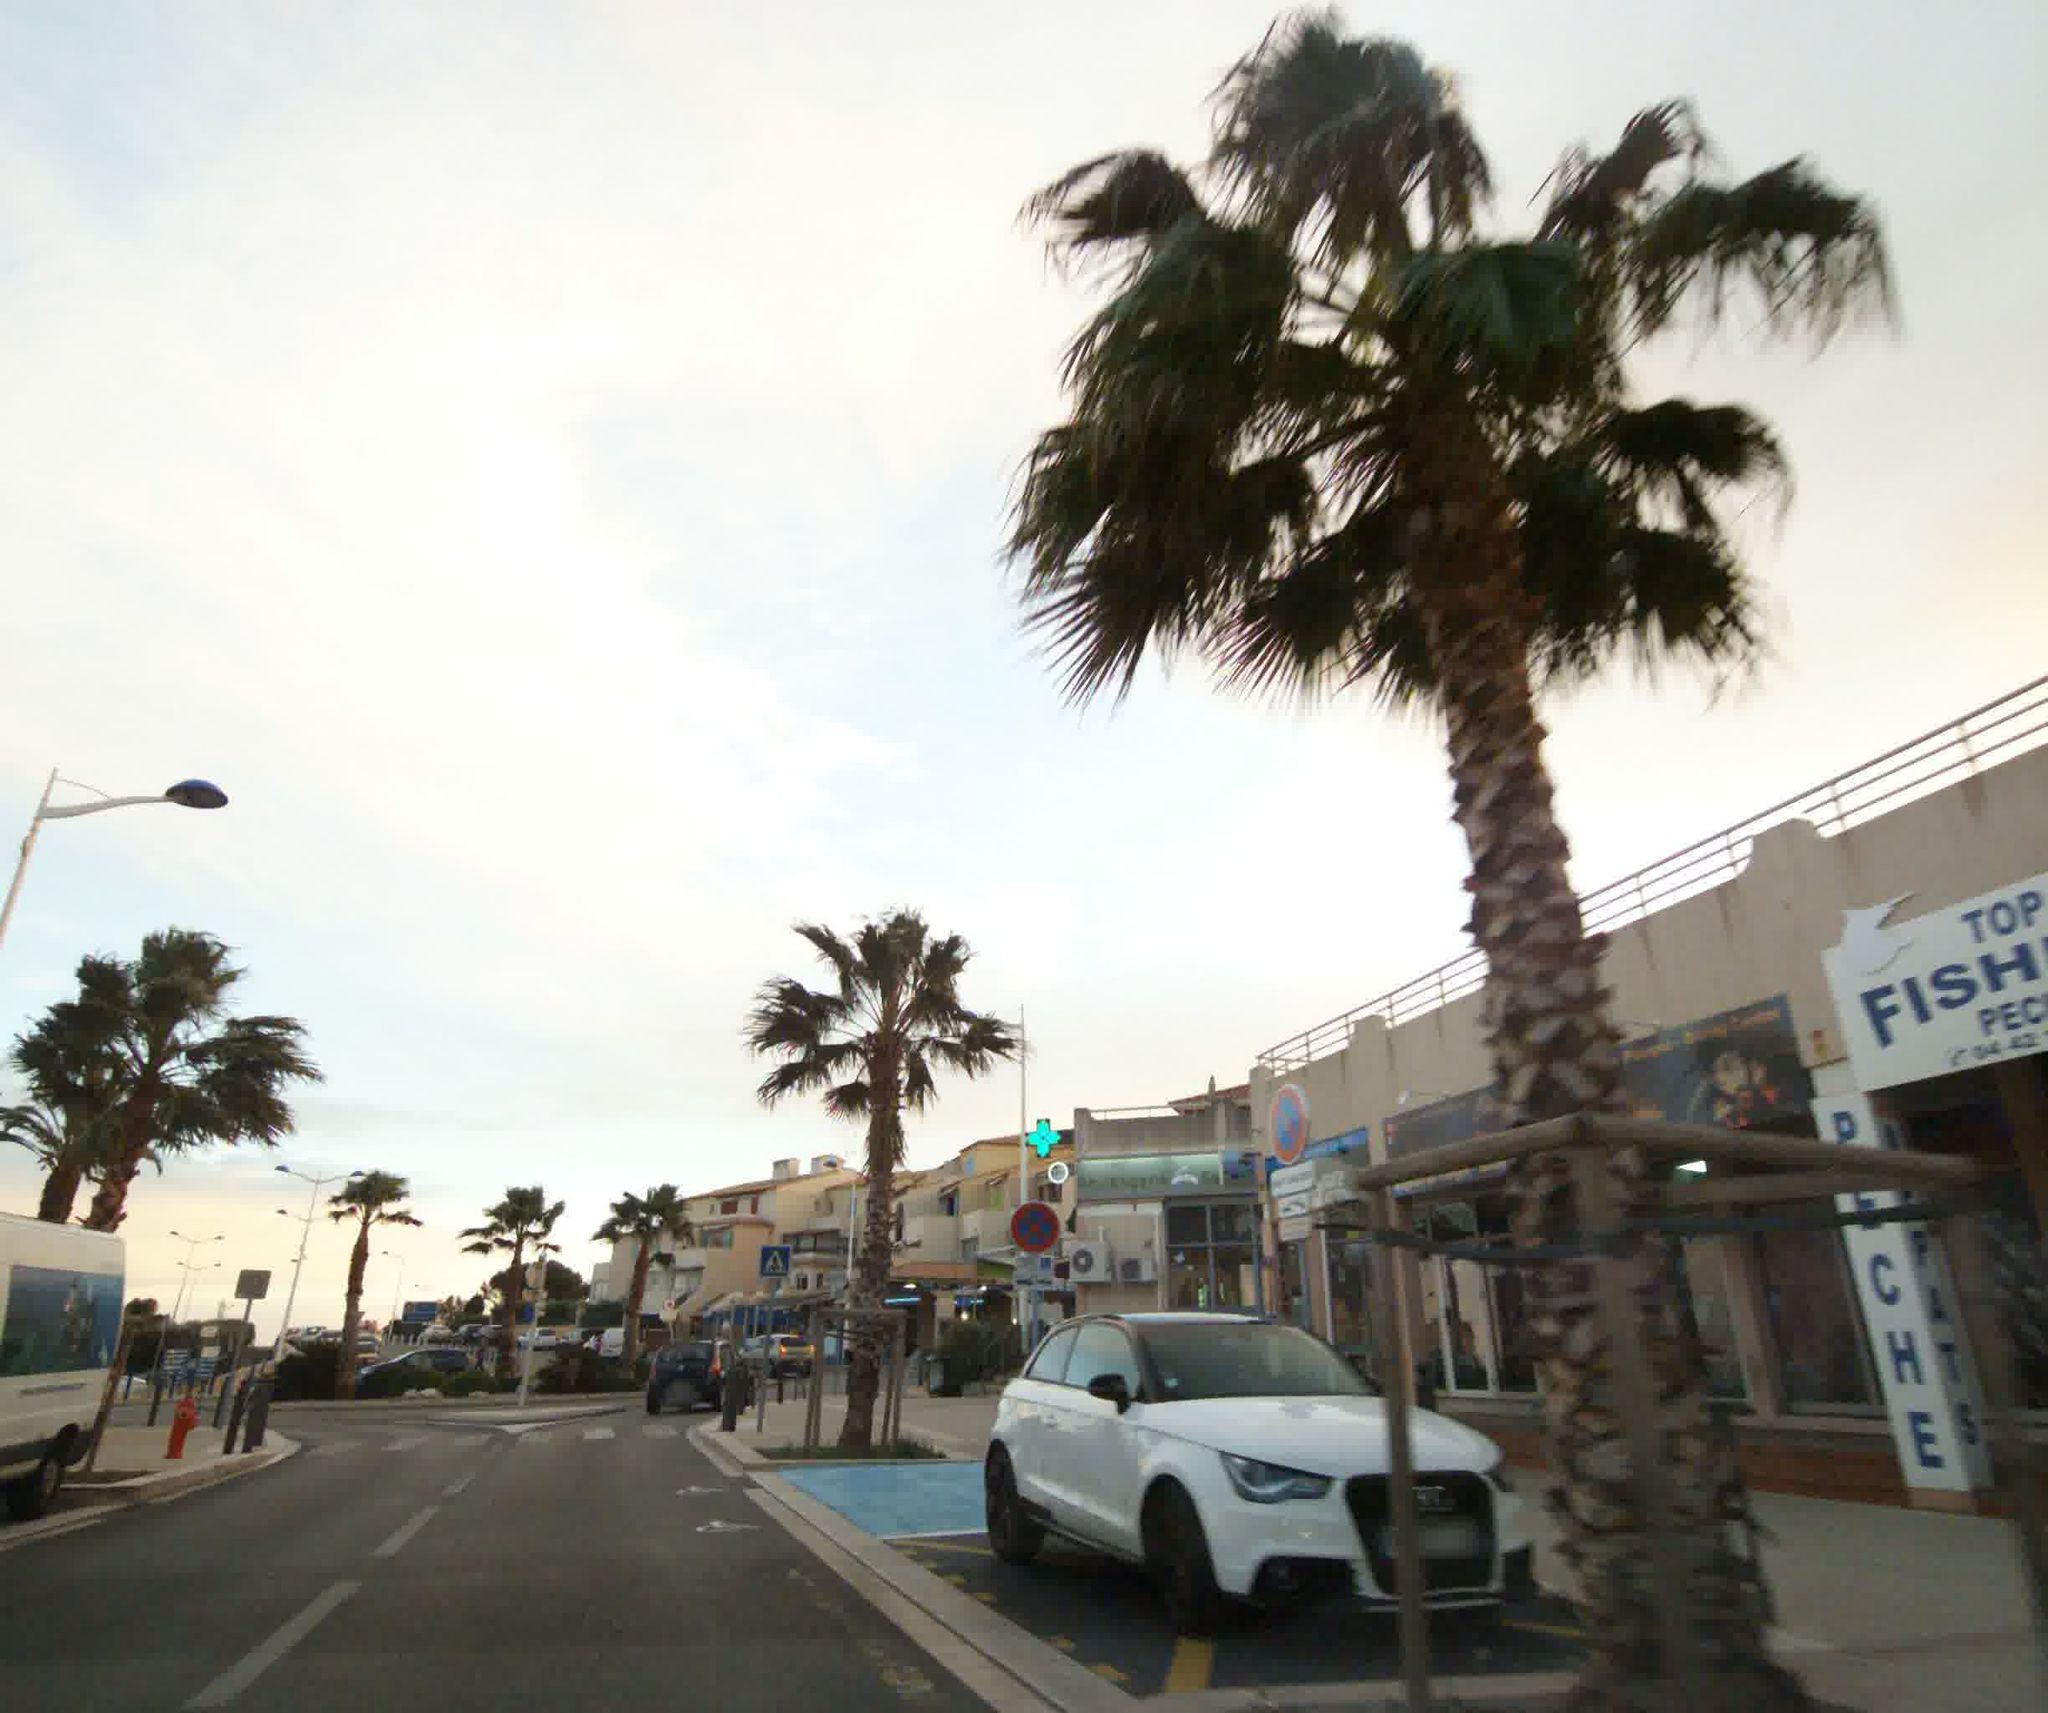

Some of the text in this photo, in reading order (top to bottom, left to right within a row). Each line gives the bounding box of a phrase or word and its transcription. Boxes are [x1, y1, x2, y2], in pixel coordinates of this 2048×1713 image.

[1960, 890, 2042, 944] TOP
[1859, 937, 2048, 1049] FISH
[1977, 992, 2048, 1037] PEC
